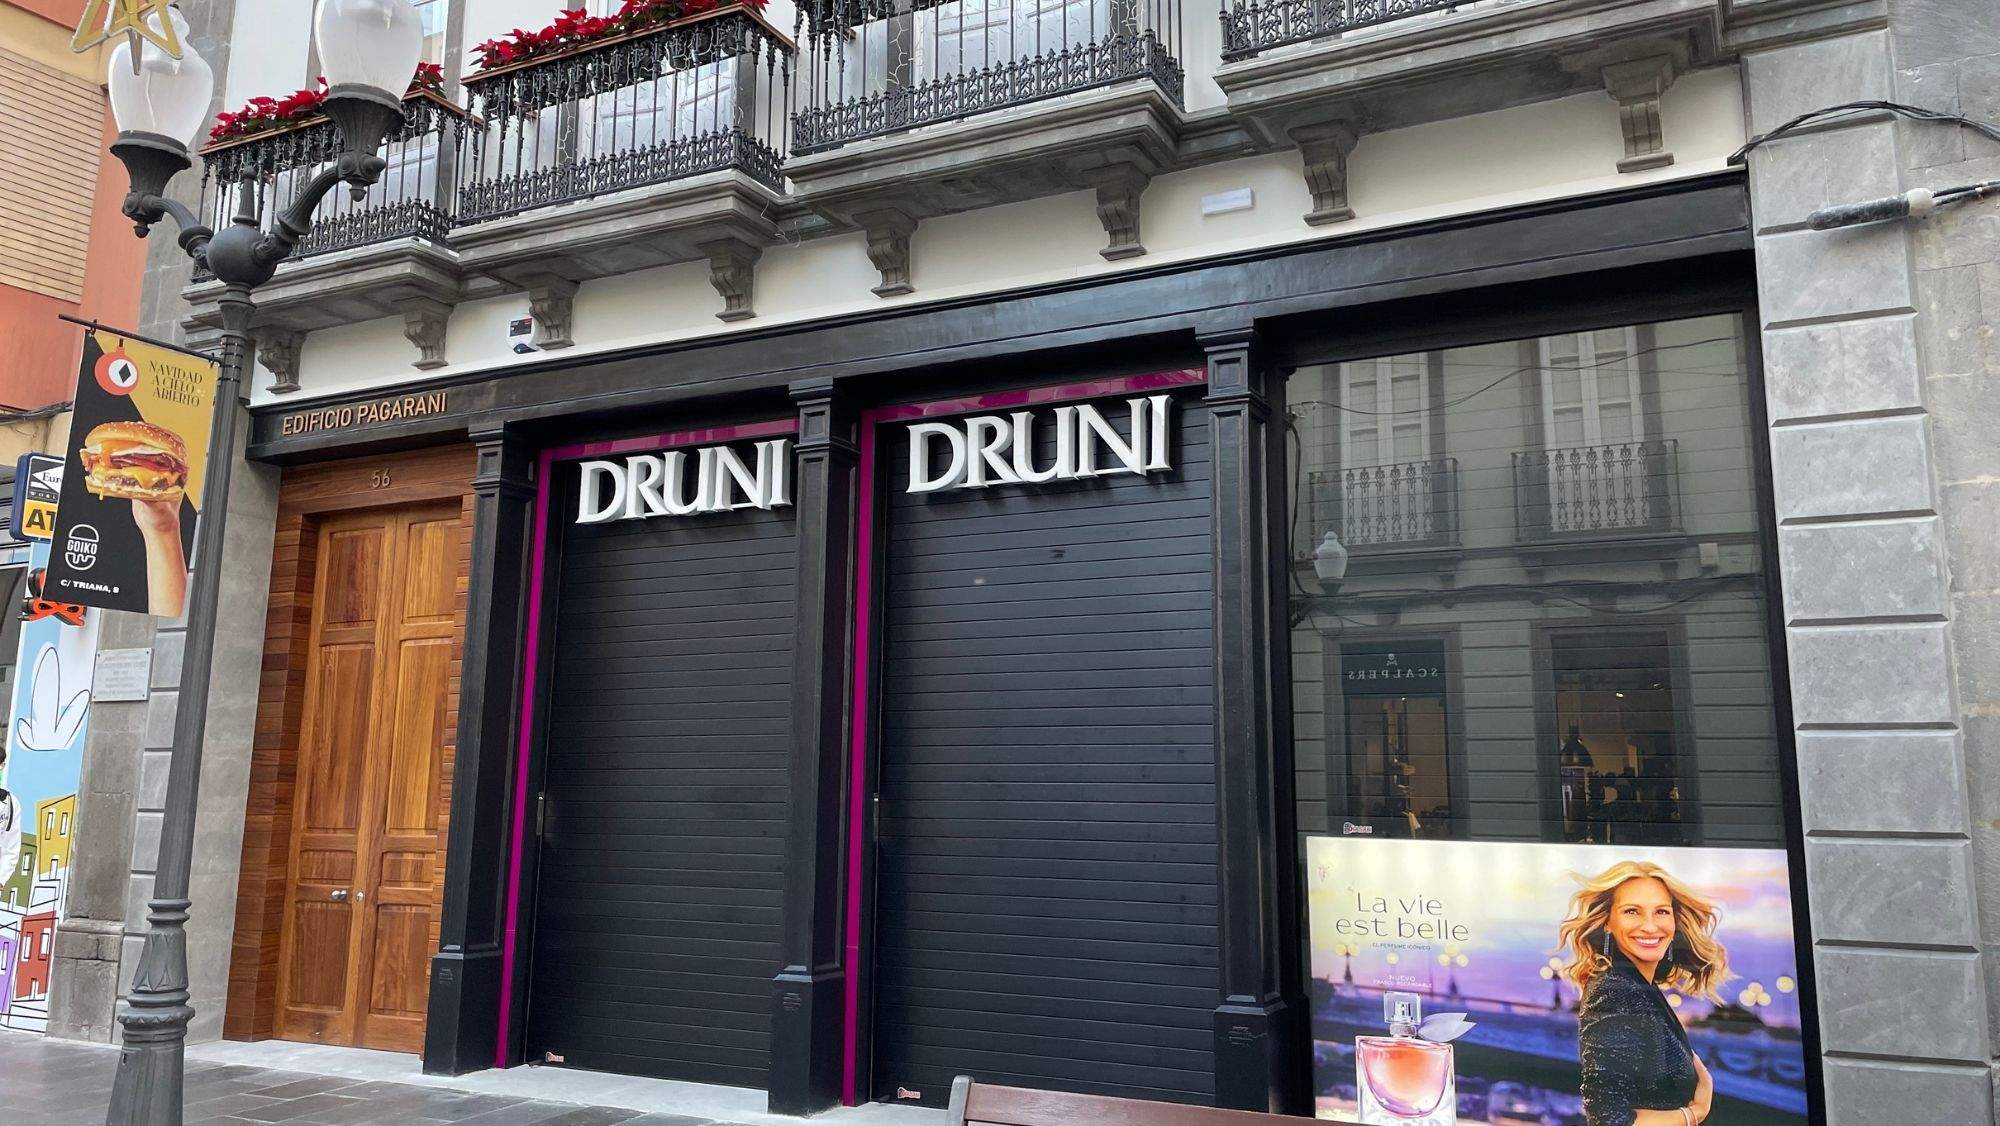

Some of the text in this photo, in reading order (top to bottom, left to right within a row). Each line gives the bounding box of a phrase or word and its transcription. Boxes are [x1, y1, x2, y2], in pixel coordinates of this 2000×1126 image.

[149, 360, 203, 385] NAVIDAD
[151, 374, 195, 395] A CIELO
[152, 387, 200, 407] ABIERTO
[282, 392, 447, 436] EDIFICIO PAGARANI
[905, 394, 1172, 494] DRUNI
[42, 471, 62, 484] Eur
[371, 468, 391, 489] 56
[575, 437, 793, 525] DRUNI
[67, 539, 98, 555] GOIKO
[60, 579, 72, 587] C/
[72, 581, 112, 594] TRIANA,
[1357, 892, 1443, 916] La vie
[1336, 917, 1470, 941] est belle
